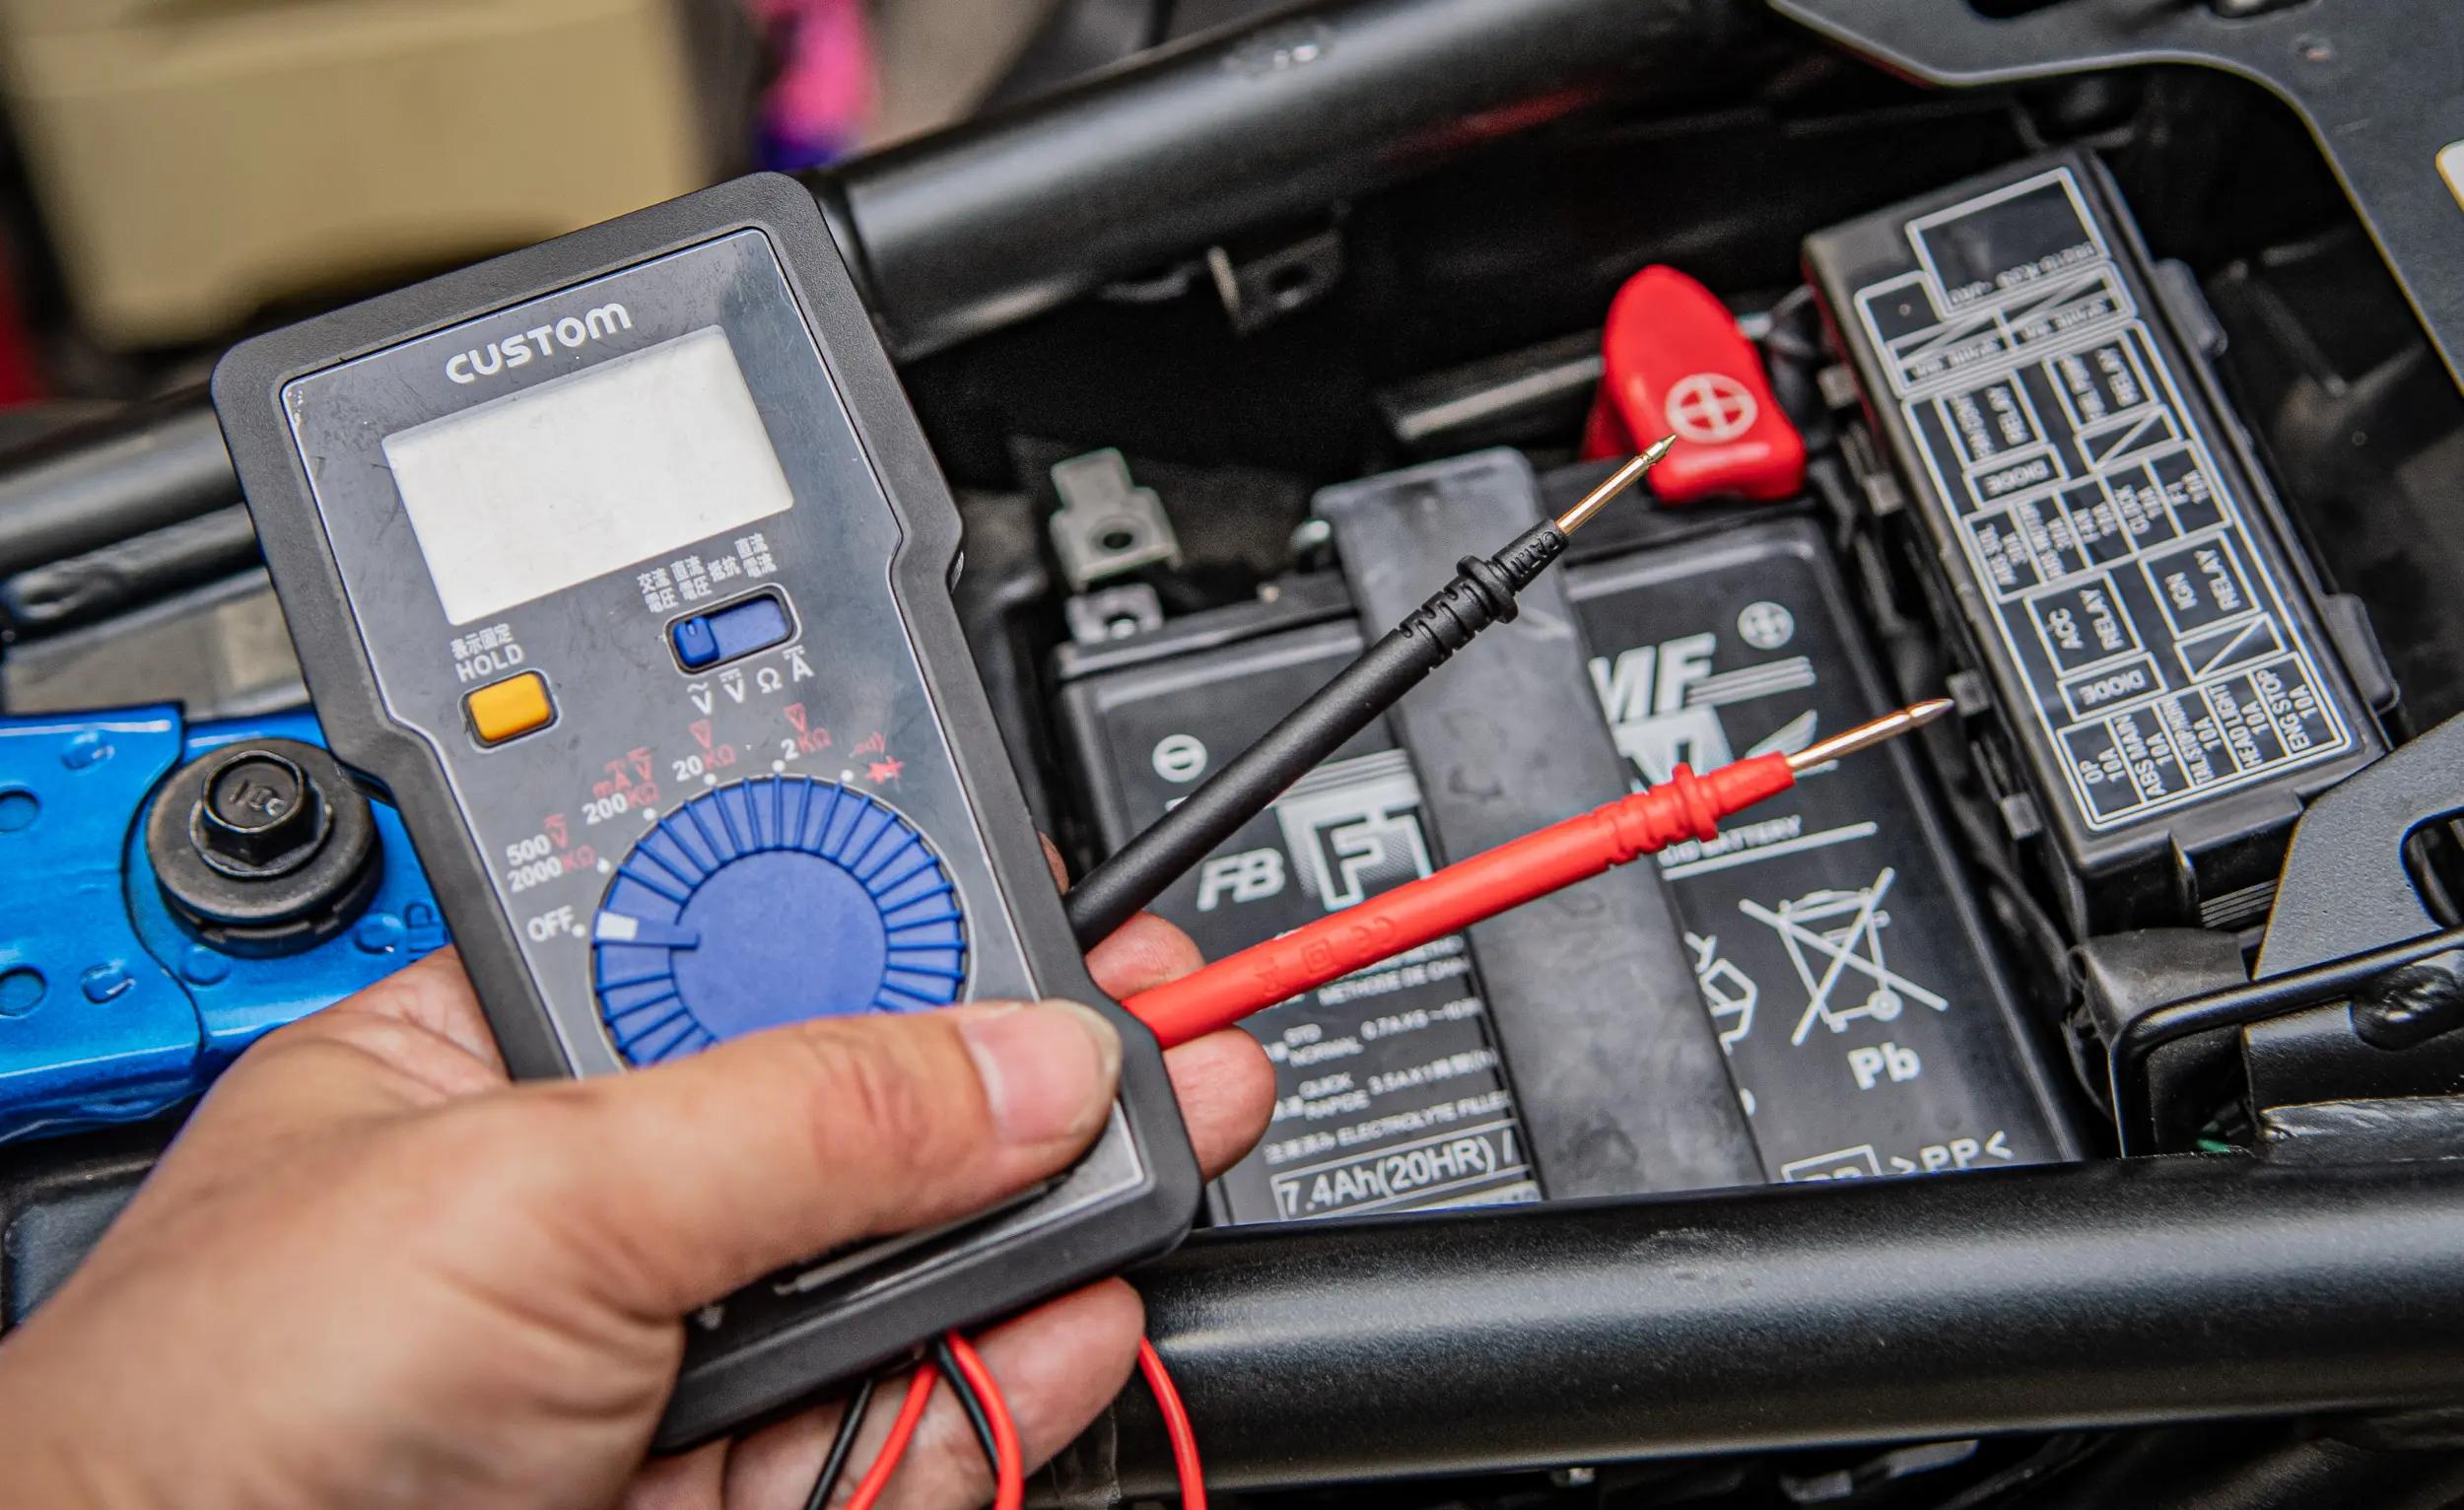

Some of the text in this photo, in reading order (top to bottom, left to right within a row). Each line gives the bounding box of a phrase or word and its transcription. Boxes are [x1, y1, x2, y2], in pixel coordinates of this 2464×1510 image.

[445, 303, 633, 384] CUSTOM
[2164, 572, 2199, 611] IGN
[2193, 549, 2242, 612] RELAY
[2048, 607, 2086, 650] ACC
[2079, 589, 2125, 651] RELAY
[455, 644, 524, 683] HOLD
[2079, 668, 2147, 705] DIODE
[2289, 683, 2319, 721] 10A
[2209, 683, 2264, 769] HEAD LIGHT
[2240, 700, 2271, 736] 10A
[2255, 668, 2313, 752] ENG STOP
[2112, 714, 2167, 797] ABS MAIN
[2146, 731, 2173, 768] 10A
[2193, 716, 2222, 752] 10A
[2098, 747, 2126, 783] 10A
[526, 906, 576, 942] OFF
[1847, 1042, 1921, 1090] Pb
[1335, 1102, 1458, 1147] ELECTROLYTE
[1280, 1134, 1496, 1215] 7.4Ah(20HR)
